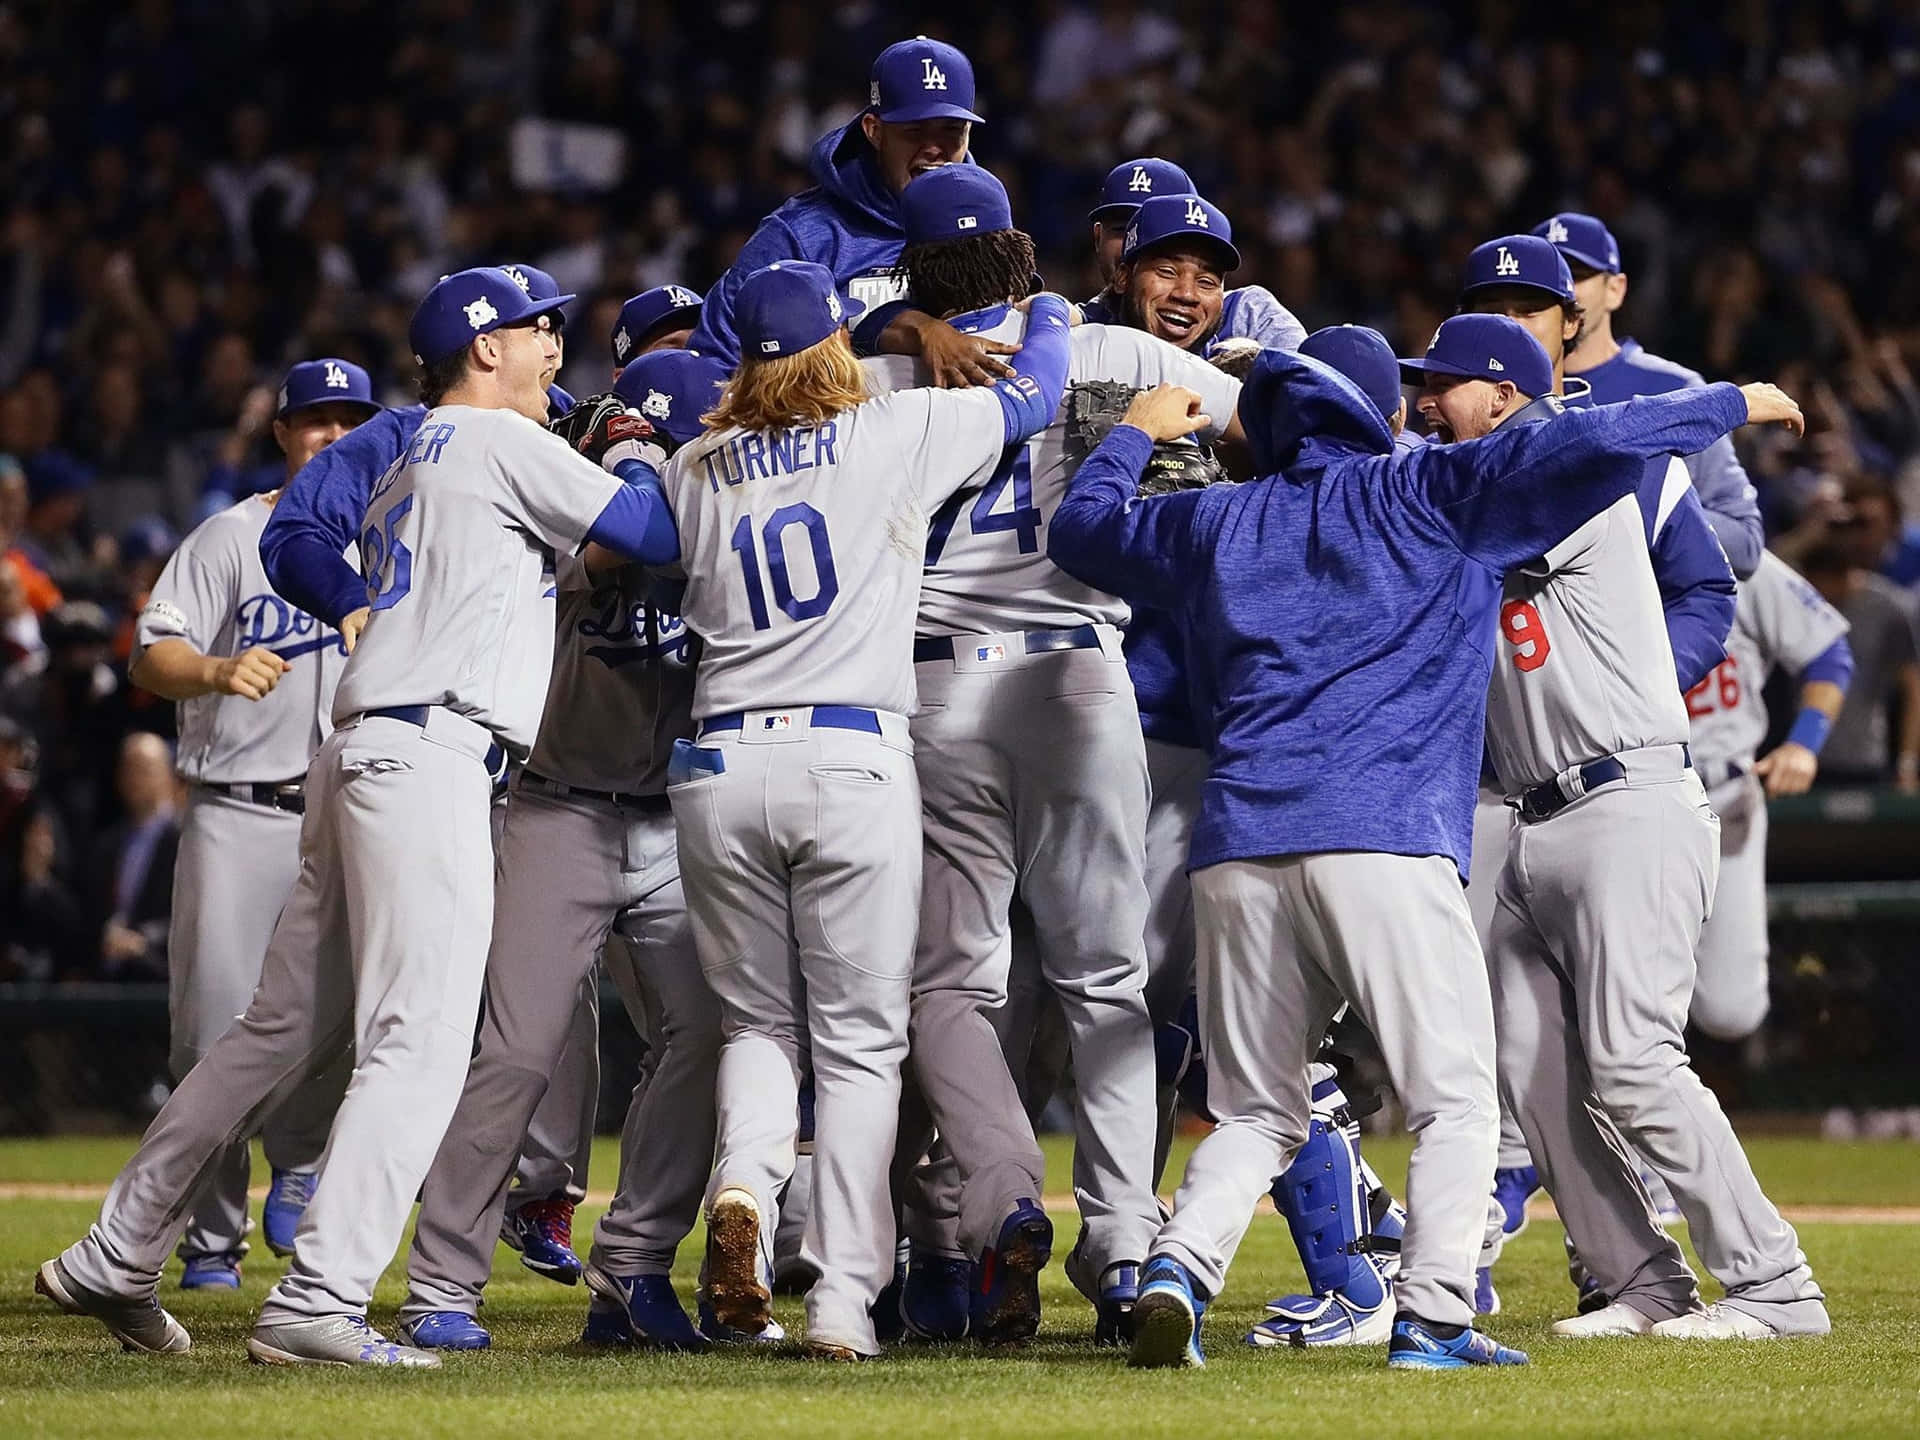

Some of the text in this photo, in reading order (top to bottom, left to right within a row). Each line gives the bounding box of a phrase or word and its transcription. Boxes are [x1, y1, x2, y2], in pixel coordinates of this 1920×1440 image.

[921, 58, 947, 90] LA
[1129, 166, 1151, 192] LA
[1185, 198, 1208, 228] LA
[1496, 246, 1520, 275] LA
[663, 285, 694, 307] LA
[324, 362, 349, 389] LA
[702, 420, 838, 494] TURNER
[730, 501, 840, 632] 10
[1500, 599, 1551, 672] 9
[1687, 655, 1741, 718] 26
